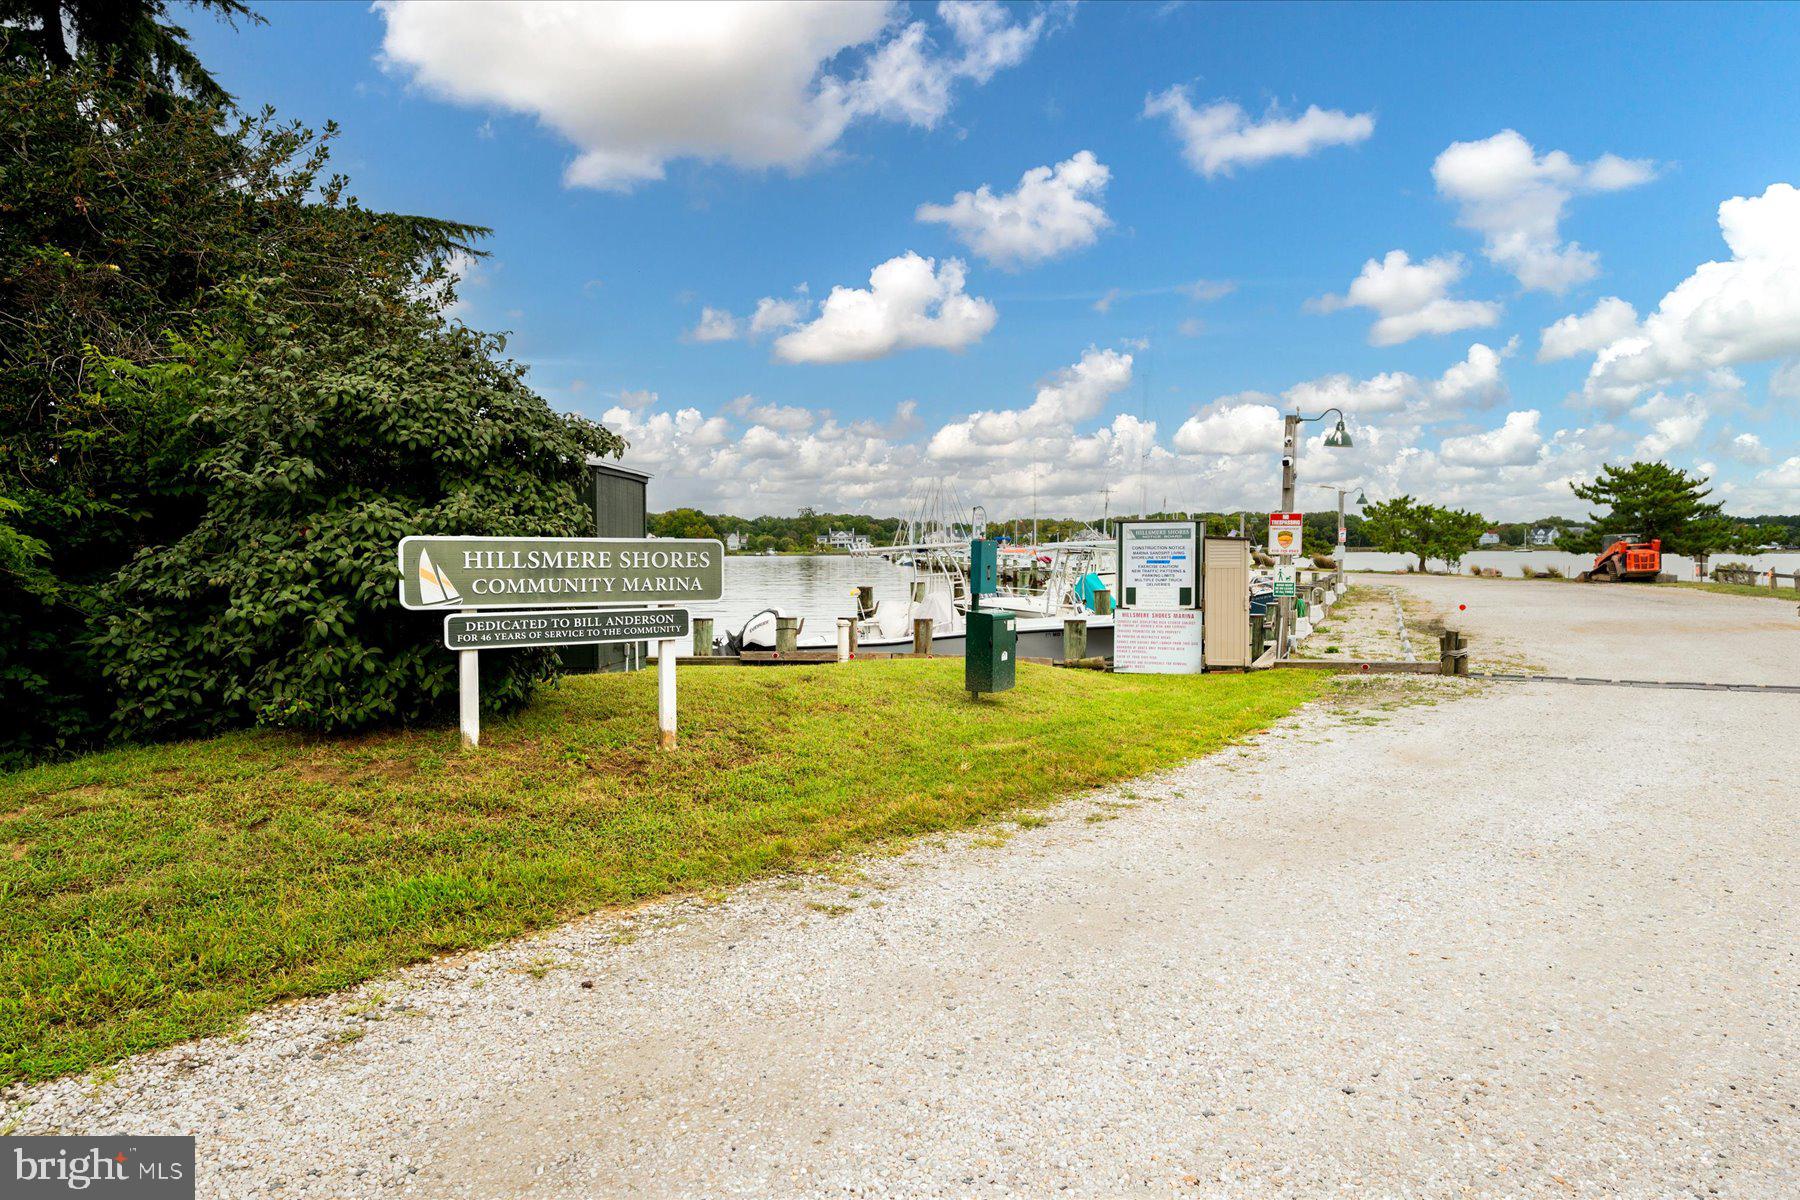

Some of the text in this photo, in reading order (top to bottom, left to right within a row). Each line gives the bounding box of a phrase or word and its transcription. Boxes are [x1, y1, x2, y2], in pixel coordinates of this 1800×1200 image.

[463, 550, 711, 569] HILLSMERE SHORES
[472, 577, 703, 595] COMMUNITY MARINA
[465, 614, 675, 632] DEDICATED TO BILL ANDERSON
[457, 625, 682, 642] FOR 46 YEARS OF SERVICE TO THE COMMUNITY
